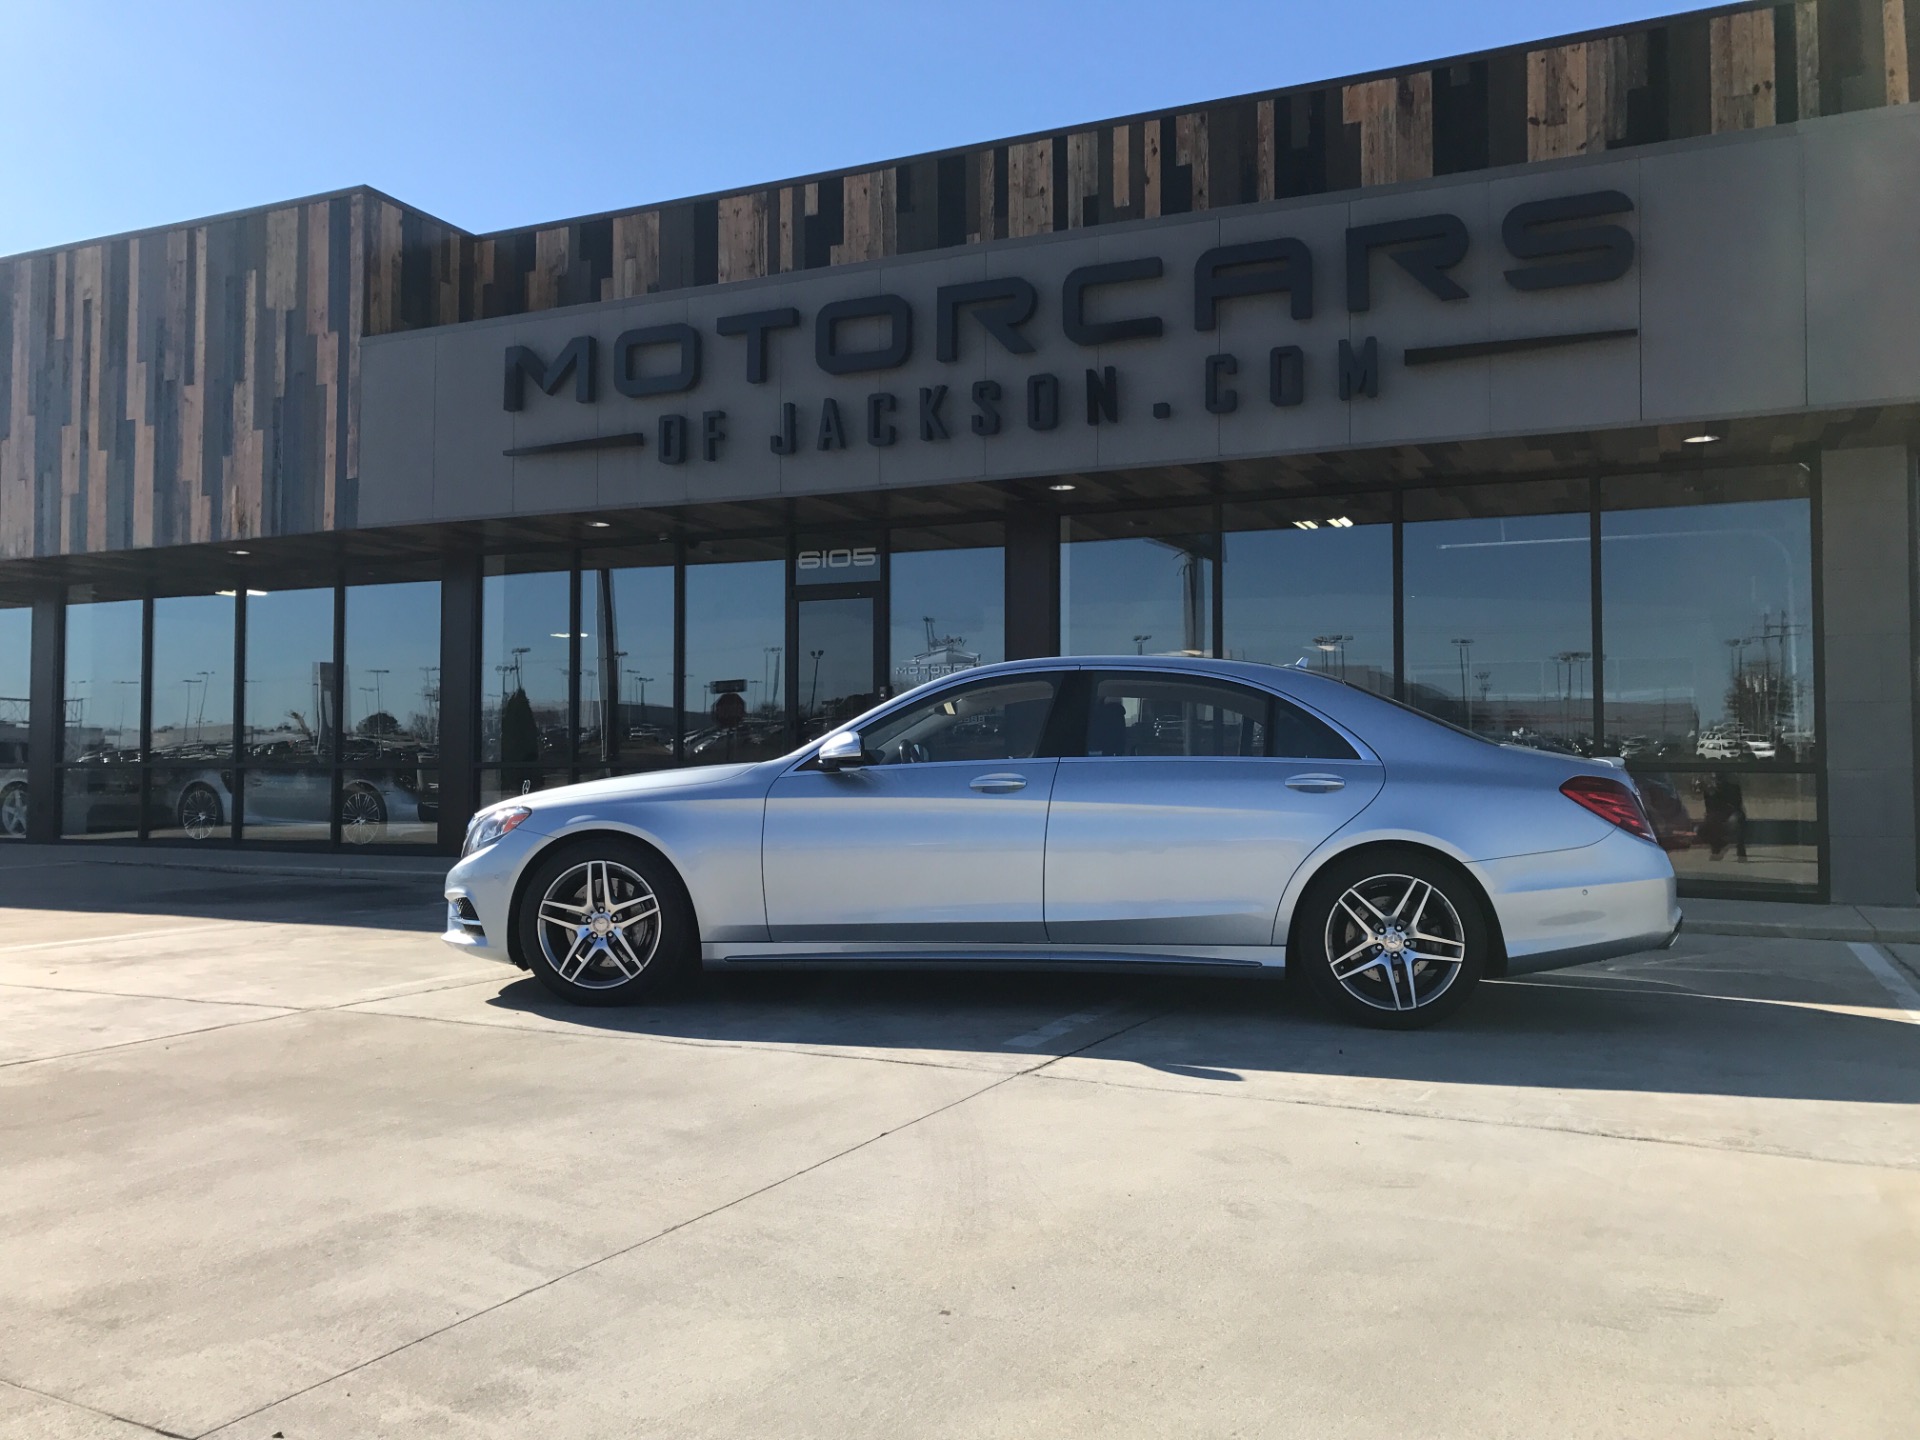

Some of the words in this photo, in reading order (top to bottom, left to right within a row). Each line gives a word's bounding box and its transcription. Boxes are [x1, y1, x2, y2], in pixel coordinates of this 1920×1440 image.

[503, 189, 1635, 412] MOTORCARS
[658, 410, 727, 464] OF
[798, 547, 876, 569] 6105
